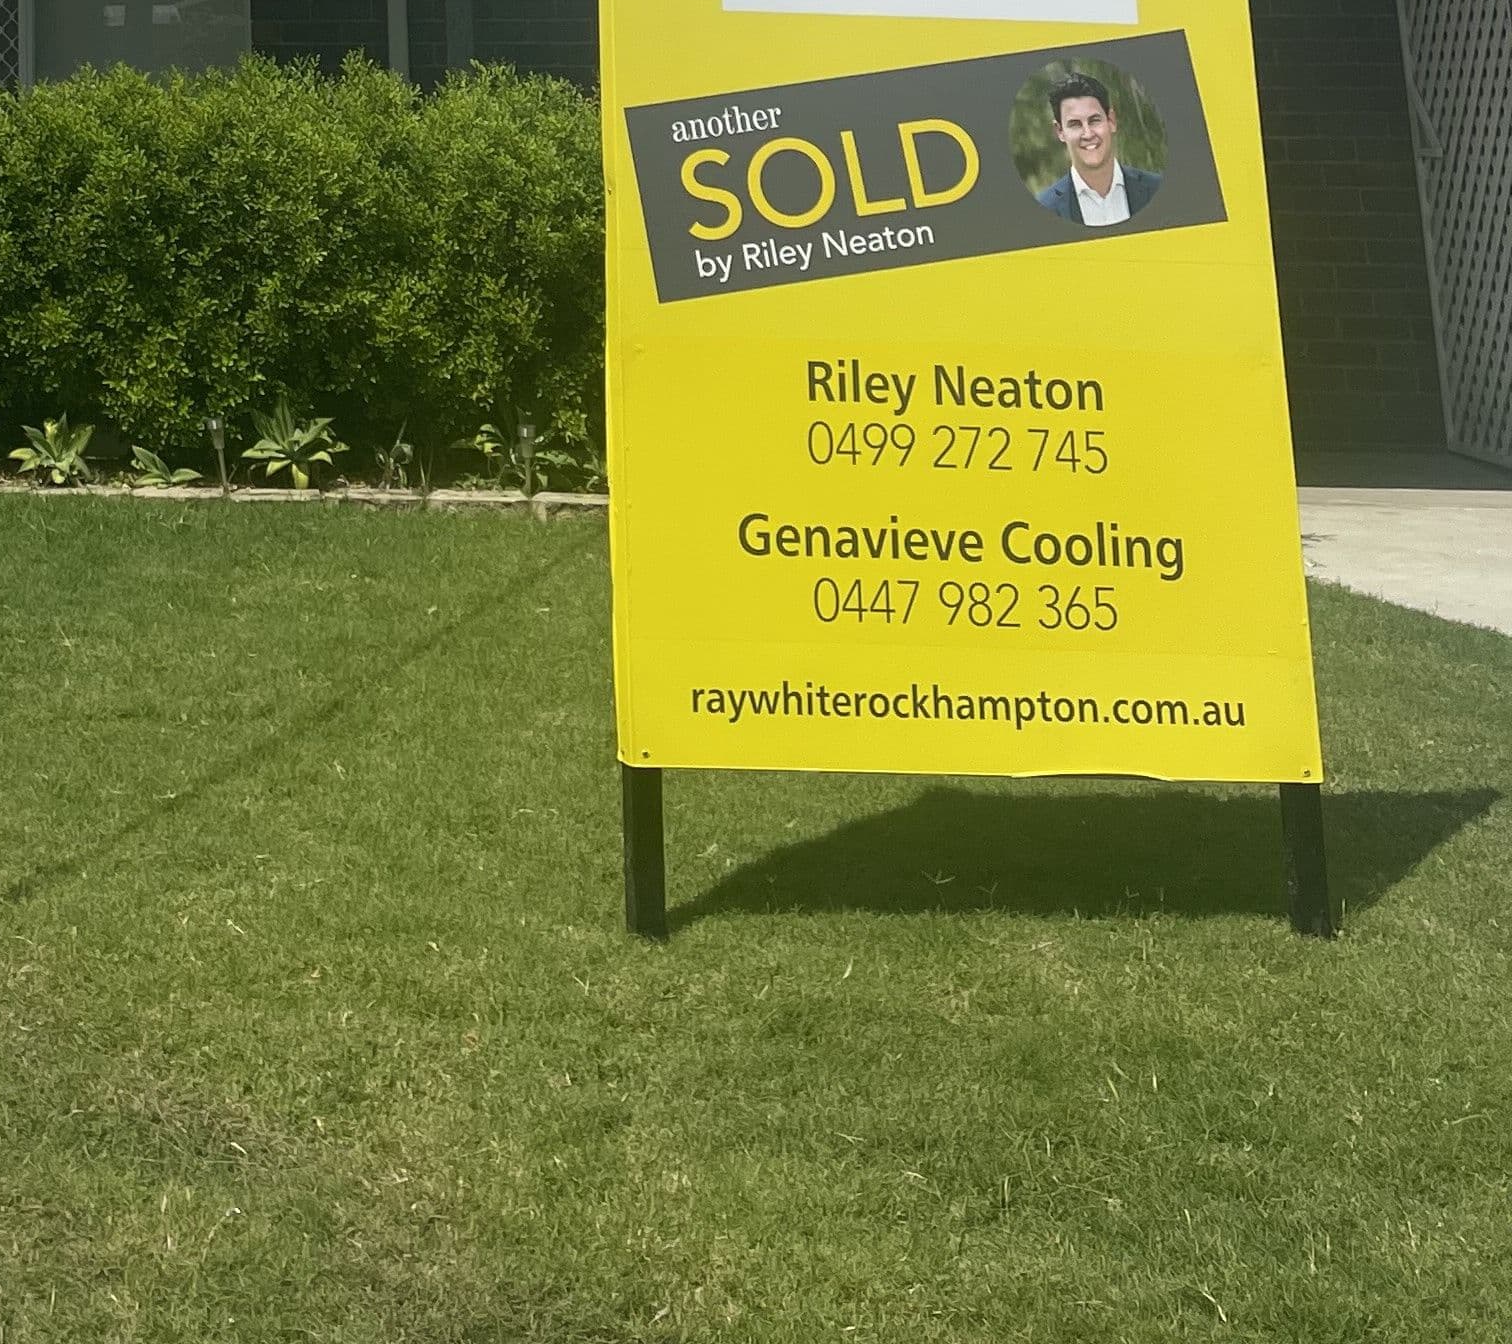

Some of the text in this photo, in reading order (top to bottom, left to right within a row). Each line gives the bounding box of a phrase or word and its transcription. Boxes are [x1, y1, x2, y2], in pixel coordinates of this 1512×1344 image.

[671, 104, 782, 143] another
[679, 118, 980, 241] SOLD
[694, 224, 934, 281] by Riley Neaton
[807, 359, 1104, 416] Riley Neaton
[807, 421, 1108, 474] 0499 272 745
[738, 513, 1185, 581] Genavieve Cooling
[813, 577, 1119, 632] 0447 982 365
[691, 680, 1246, 730] raywhiterockhampton.com.au
